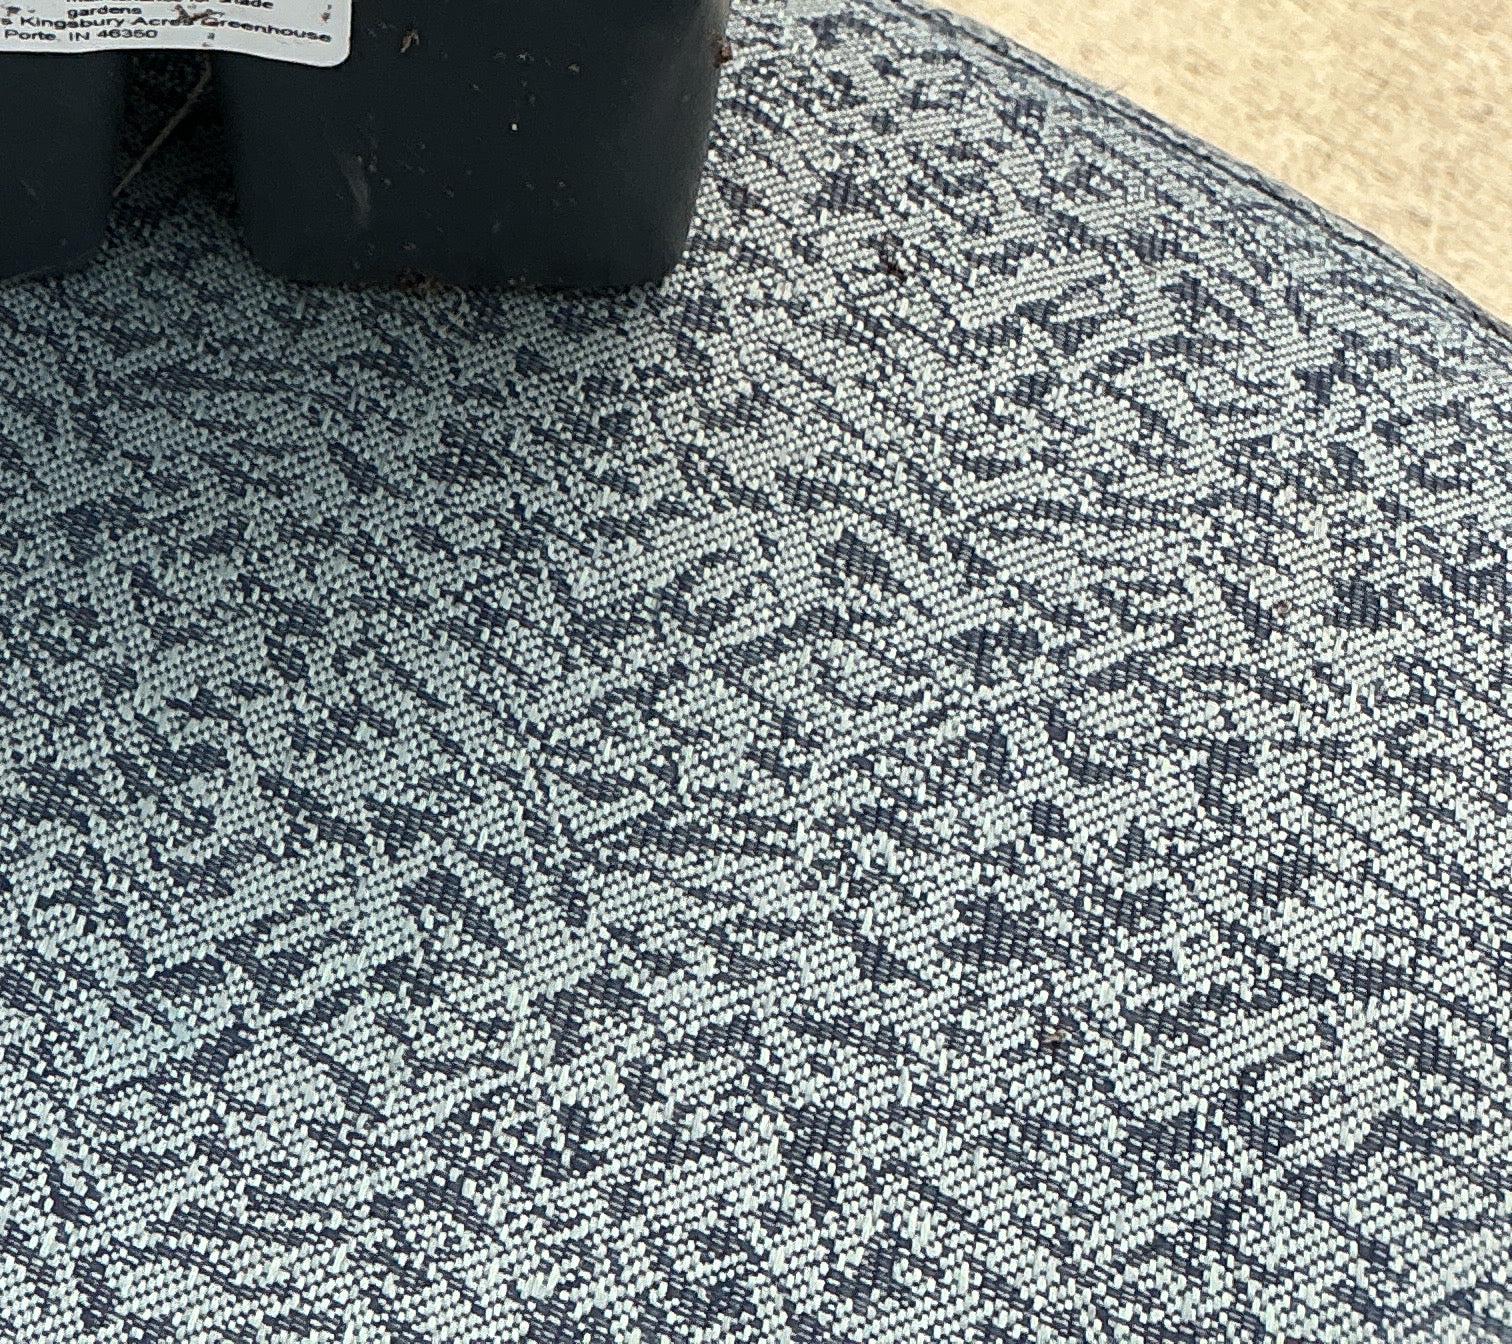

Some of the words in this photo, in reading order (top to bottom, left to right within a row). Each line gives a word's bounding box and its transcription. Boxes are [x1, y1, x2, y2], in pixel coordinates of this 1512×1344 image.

[67, 5, 142, 19] gardens
[20, 16, 124, 31] Kingsbury
[201, 17, 332, 43] Greenhouse
[69, 31, 90, 41] IN
[96, 29, 158, 39] 46350
